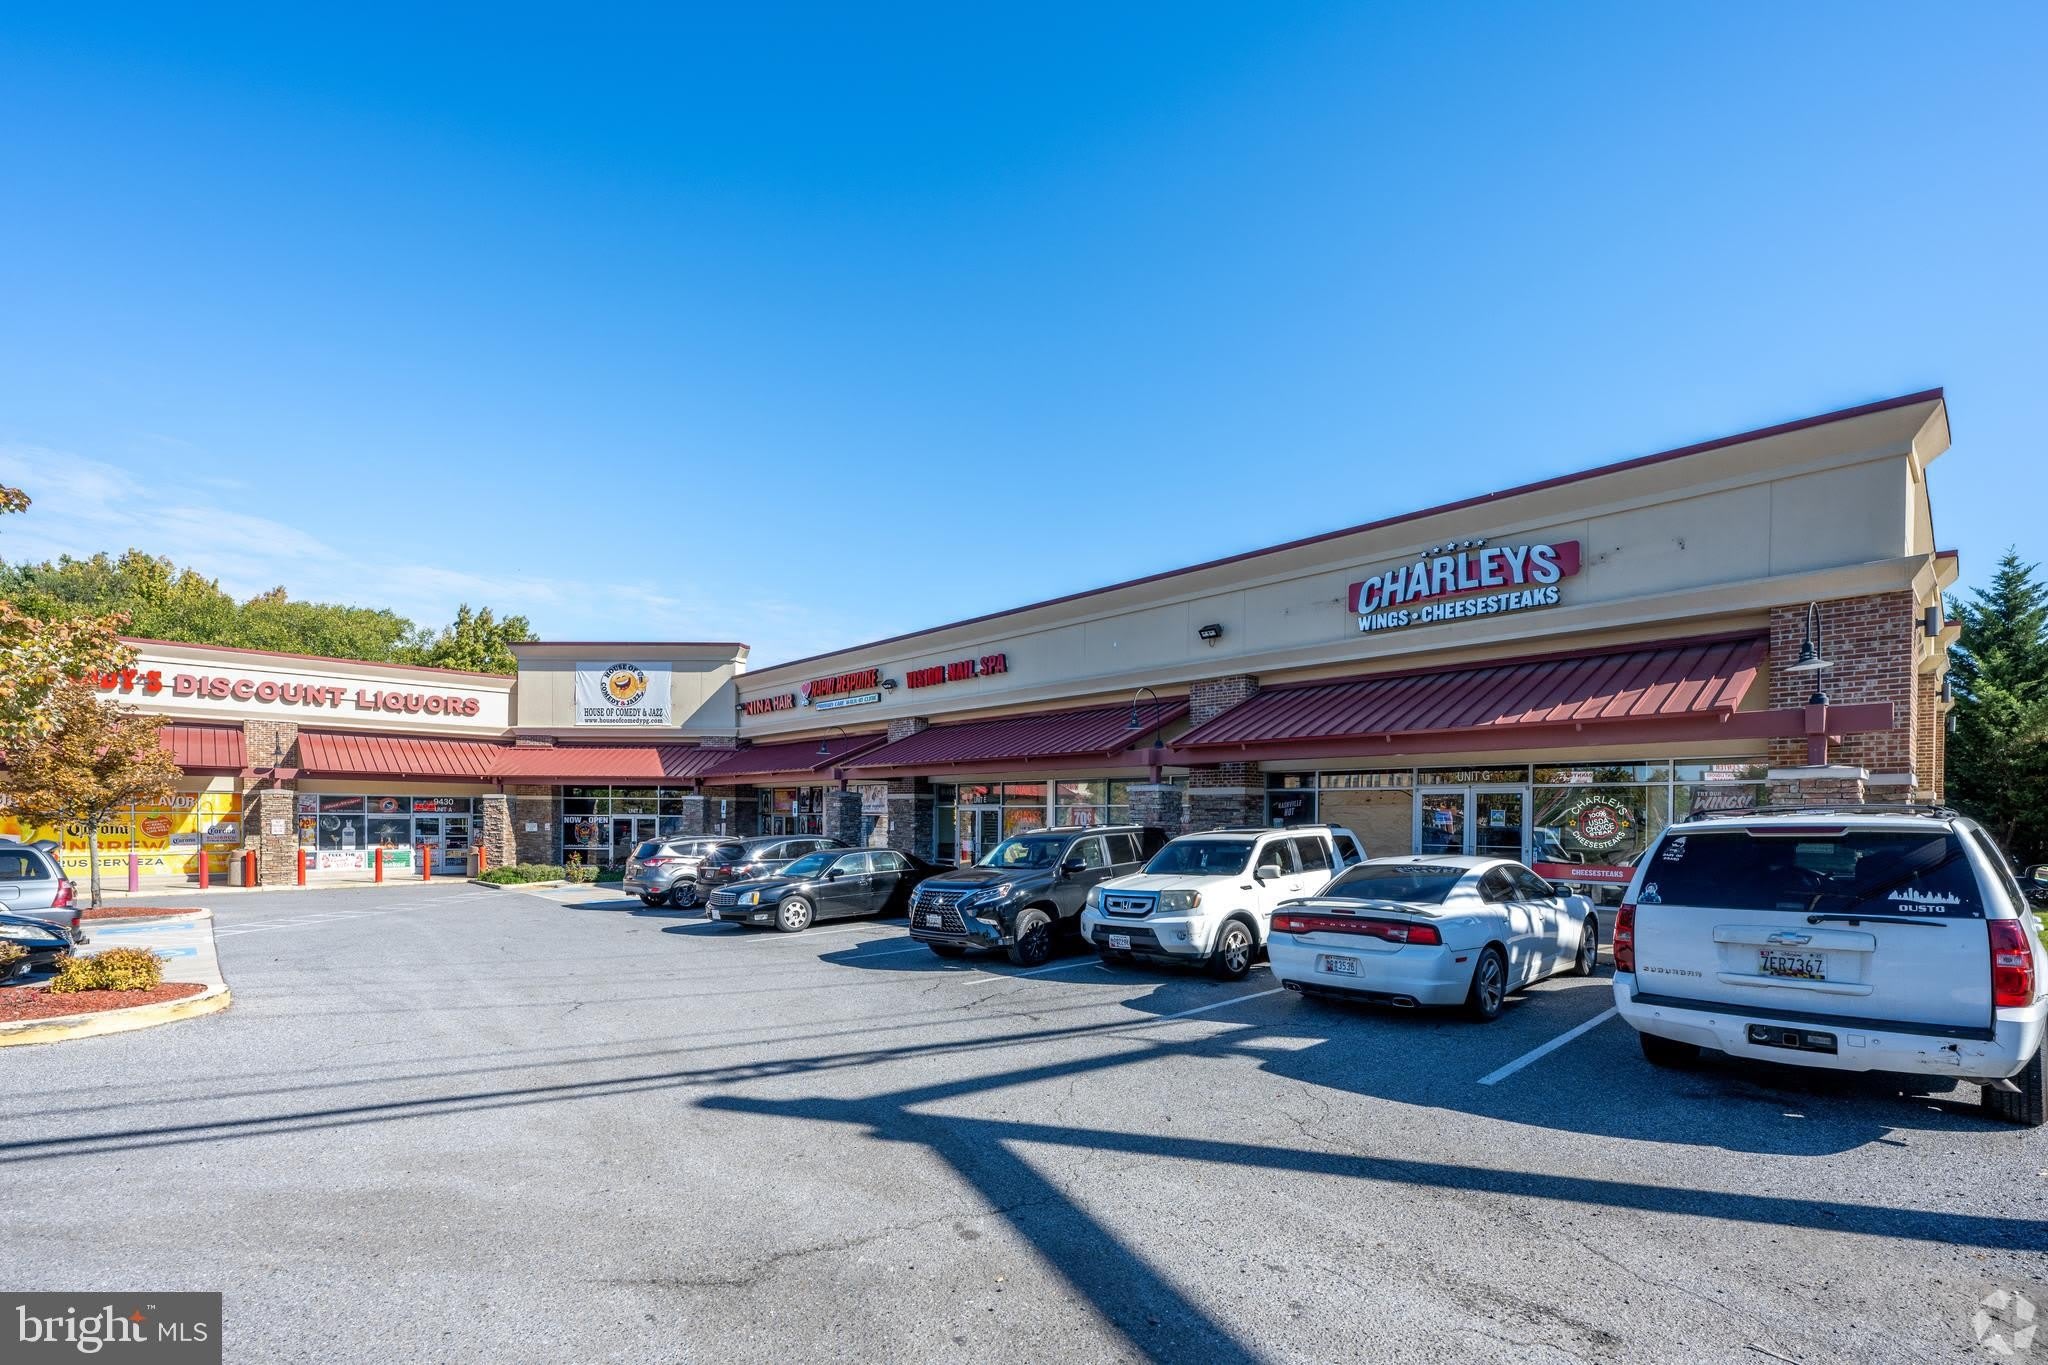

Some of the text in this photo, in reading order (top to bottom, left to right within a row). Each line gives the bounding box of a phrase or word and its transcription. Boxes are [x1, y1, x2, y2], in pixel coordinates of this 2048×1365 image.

[1358, 544, 1561, 614] CHARLEYS
[1358, 586, 1560, 632] WINGS CHEESESTEAKS
[605, 664, 627, 678] HOUSE
[907, 654, 1007, 688] VISION NAIL SPA
[811, 669, 878, 697] RAPID RESPONSE
[176, 673, 347, 705] DISCOUNT
[356, 689, 480, 715] LIQUORS
[600, 682, 620, 706] COMEDY
[584, 708, 663, 717] HOUSE OF COMEDY & JAZZ
[746, 694, 793, 715] NINA HAIR
[1458, 771, 1490, 781] UNIT G
[150, 796, 196, 808] LAVOR
[433, 798, 454, 806] 9430
[1571, 795, 1628, 815] CHARLEYS
[1694, 795, 1753, 808] WINGS!
[1585, 823, 1615, 834] CHOICE
[1572, 830, 1626, 849] CHEESESTEAKS
[1571, 868, 1624, 878] CHEESESTEAKS
